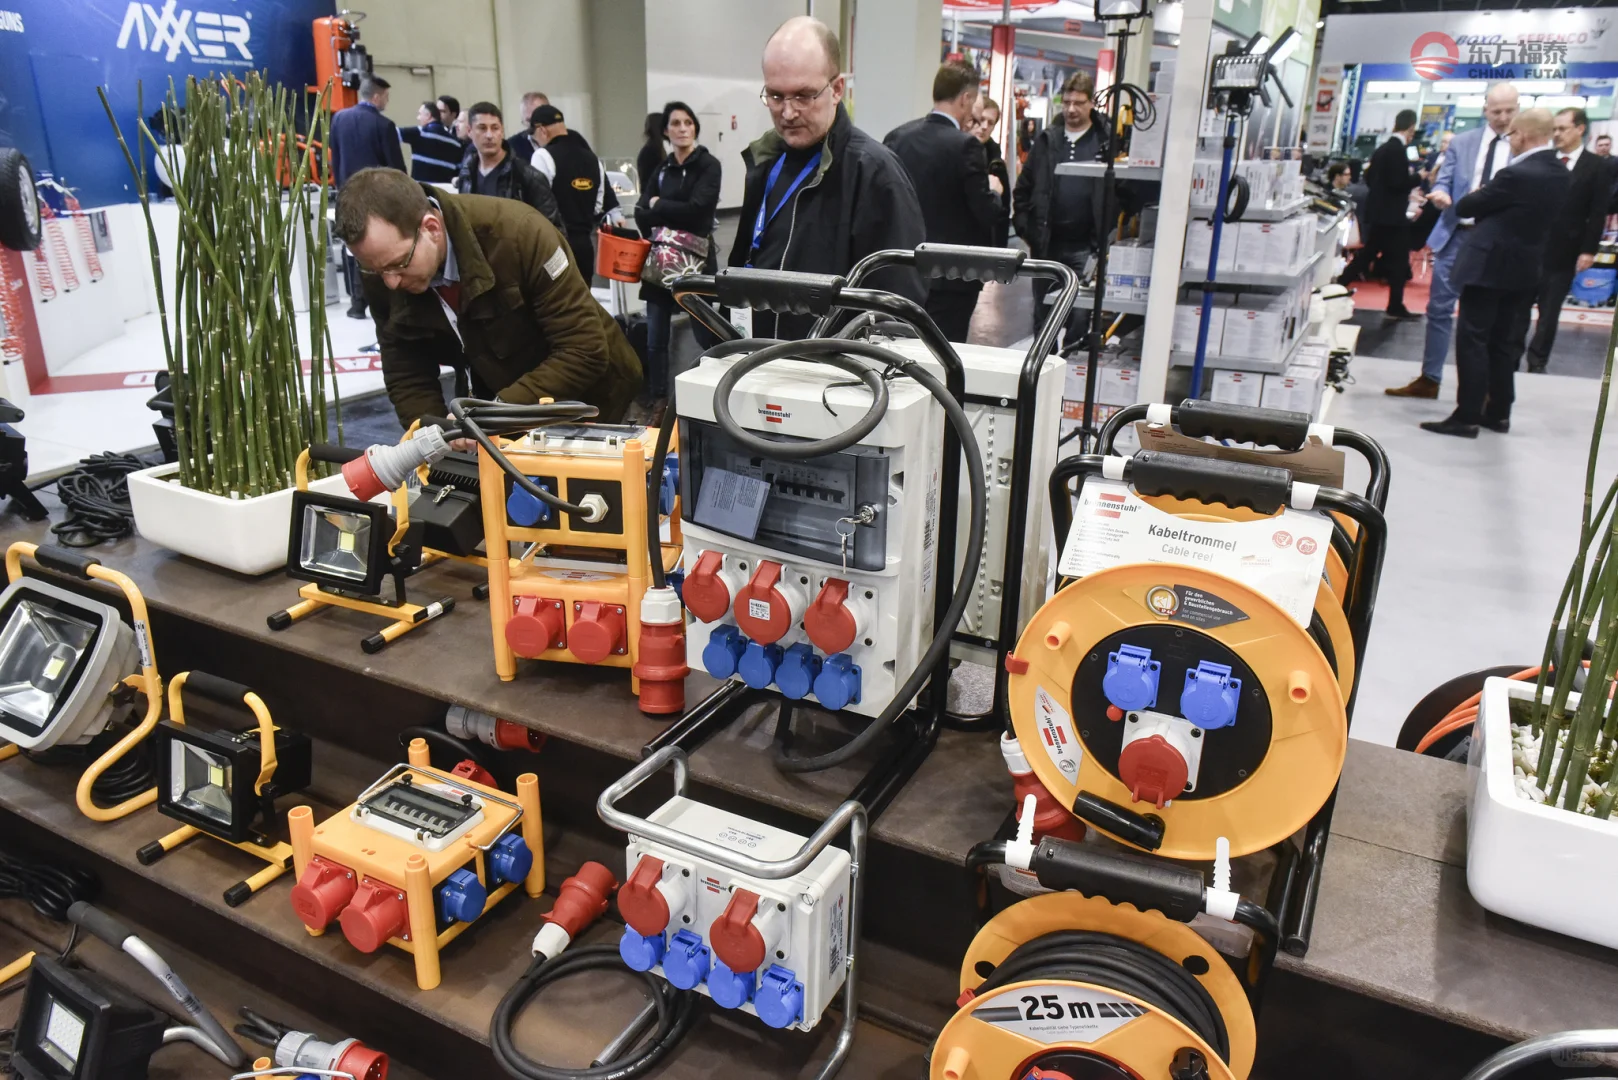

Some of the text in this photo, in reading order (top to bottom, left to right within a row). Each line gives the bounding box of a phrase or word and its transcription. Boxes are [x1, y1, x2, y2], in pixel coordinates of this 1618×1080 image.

[758, 408, 791, 418] brennenstuhl
[1084, 498, 1138, 512] bnnenstuhl
[1148, 524, 1237, 552] Kabeltrommel
[1162, 543, 1214, 563] Cable reel
[1046, 717, 1063, 754] brennenstuhl
[1020, 995, 1095, 1020] 25 m
